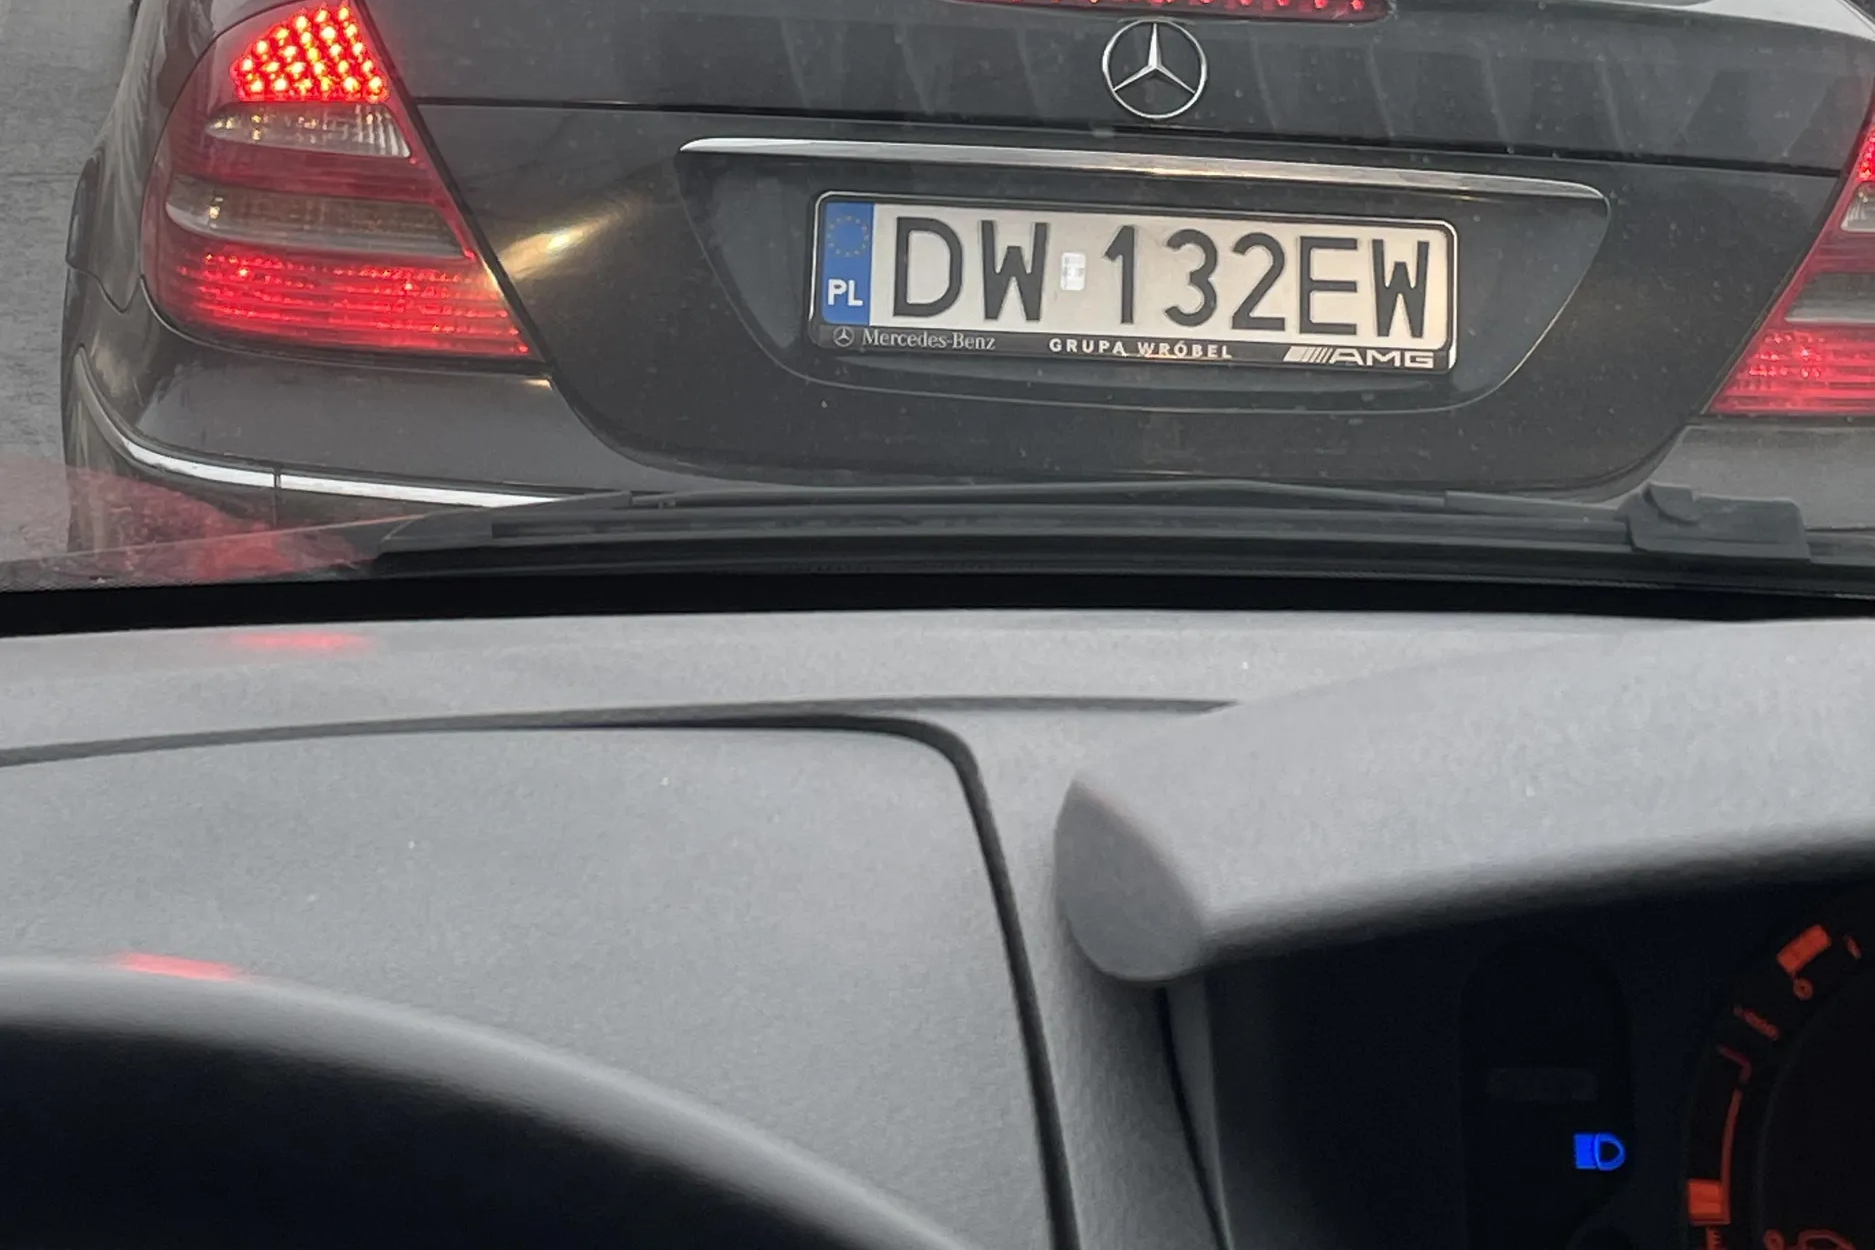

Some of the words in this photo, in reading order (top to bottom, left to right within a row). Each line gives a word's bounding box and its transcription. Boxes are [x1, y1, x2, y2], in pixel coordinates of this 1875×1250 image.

[893, 216, 1048, 321] DW
[1104, 224, 1432, 338] 132EW
[827, 278, 863, 306] PL
[861, 328, 997, 351] Mercedes-Benz
[1048, 337, 1127, 355] GRUPA
[1137, 338, 1233, 360] WRÓBEL
[1330, 349, 1434, 368] AMG
